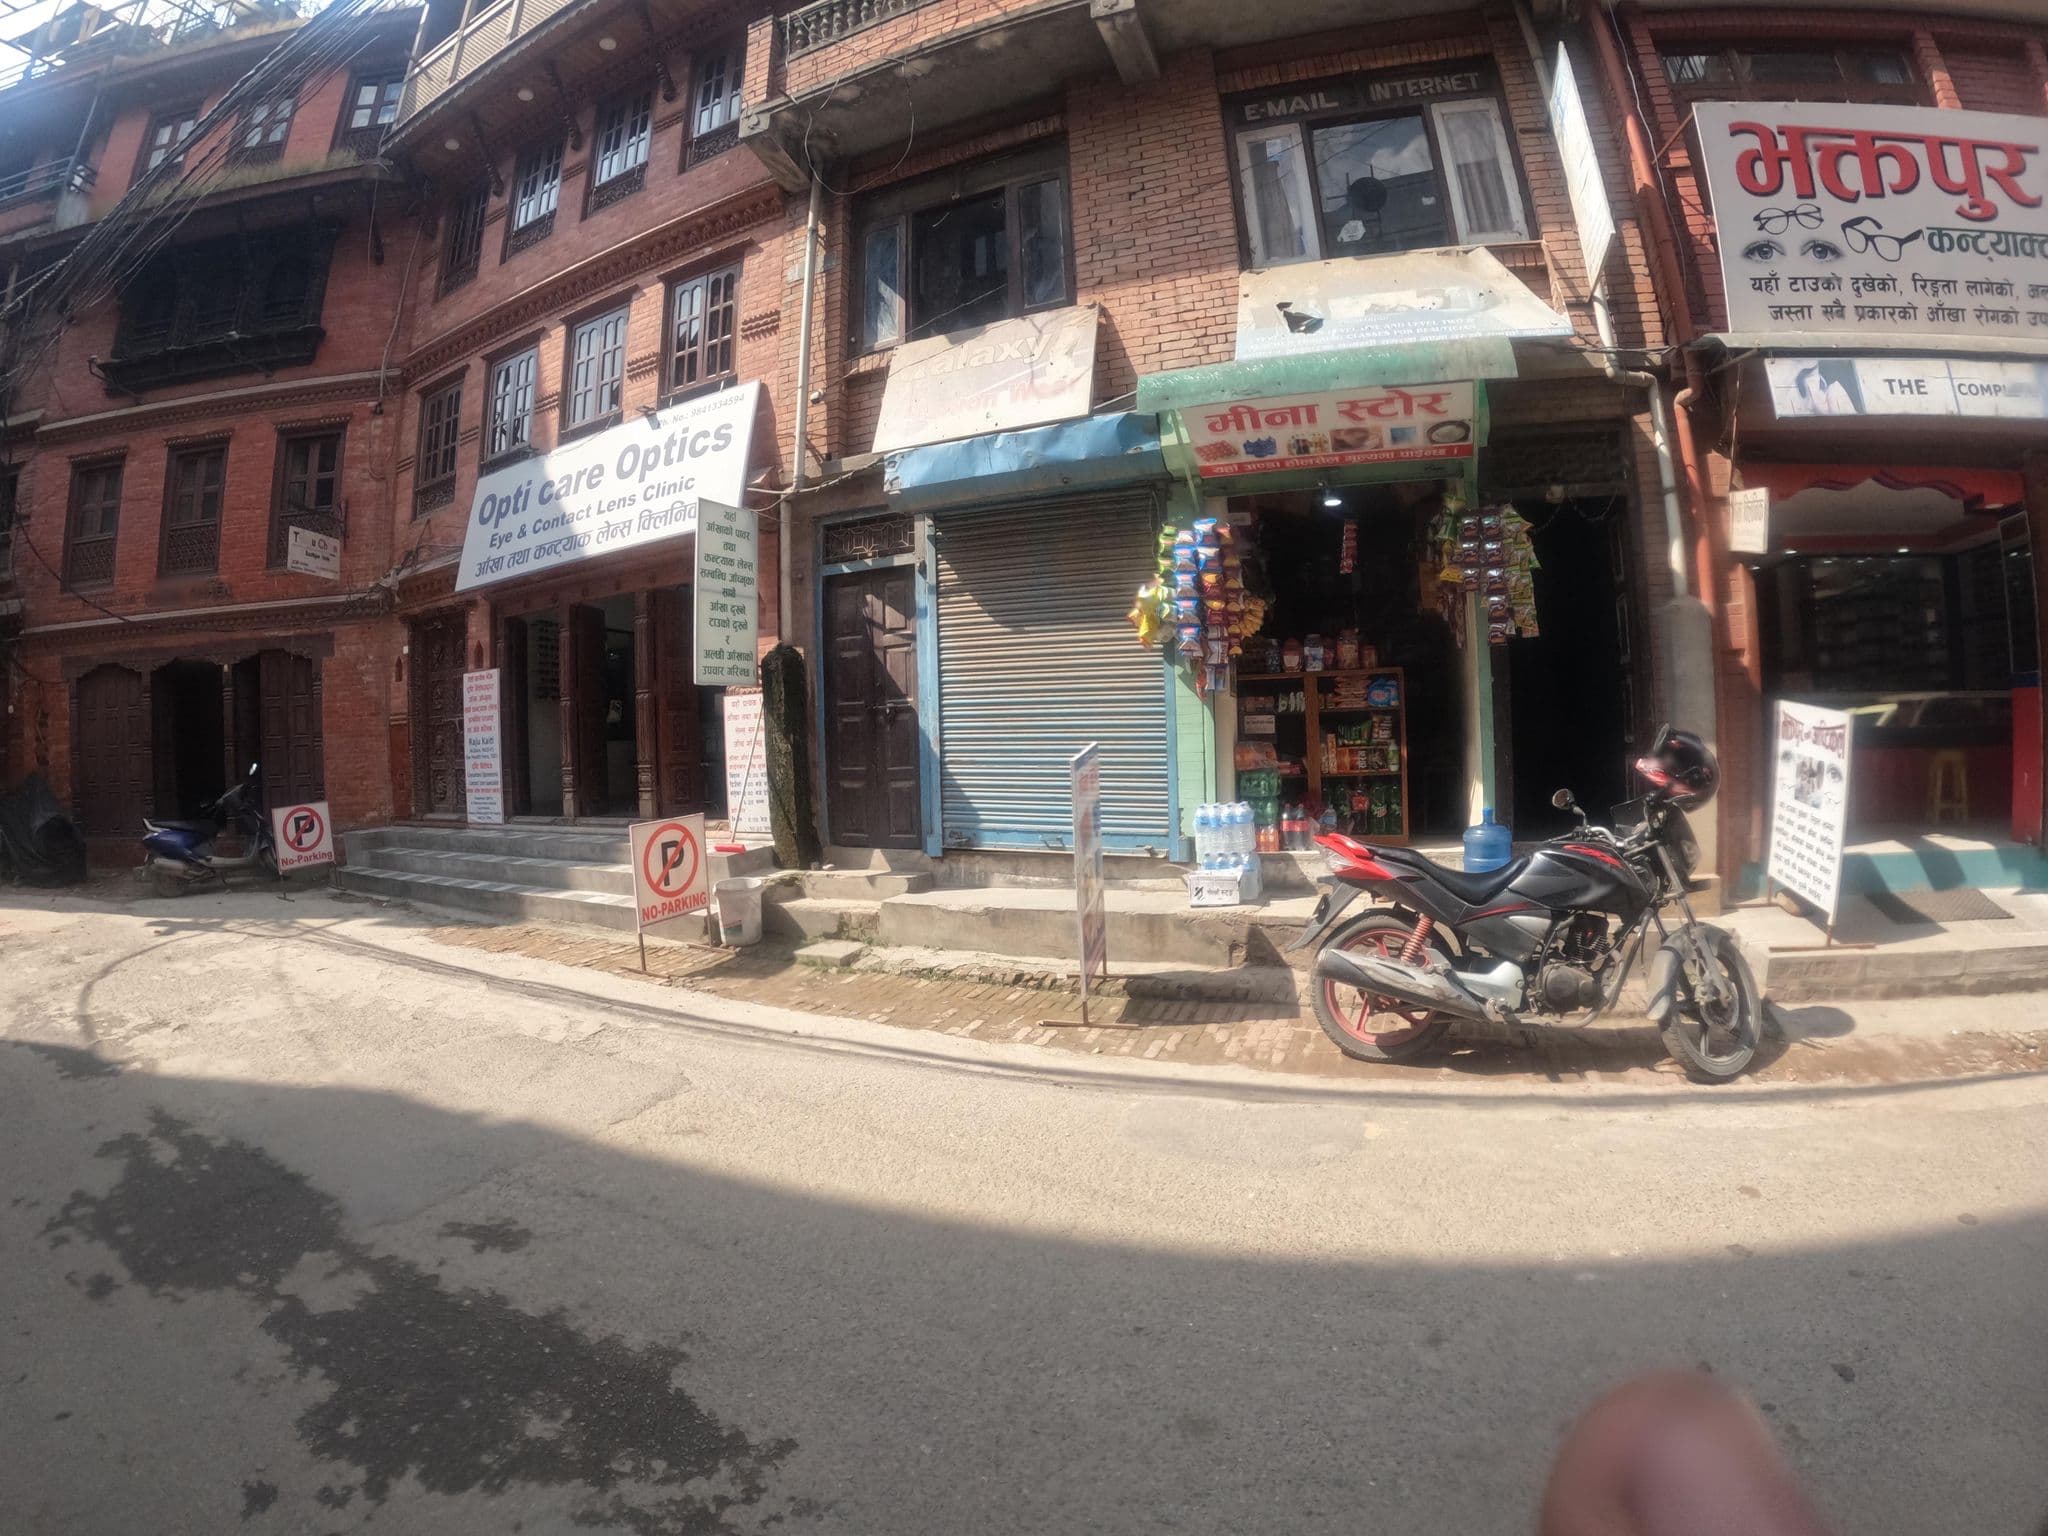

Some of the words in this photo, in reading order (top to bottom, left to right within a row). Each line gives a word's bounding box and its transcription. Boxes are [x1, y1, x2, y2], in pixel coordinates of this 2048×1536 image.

[1244, 91, 1340, 121] E-MAIL
[1369, 72, 1480, 101] INTERNET
[1728, 121, 2043, 222] भक्तपुर
[1788, 272, 1843, 293] टाउको
[1768, 304, 1813, 322] जस्ता
[1821, 298, 1846, 321] सबै
[1854, 301, 1919, 324] प्रकारको
[1883, 377, 1929, 396] THE
[1204, 404, 1320, 434] मीना
[1336, 388, 1452, 422] स्टोर
[478, 480, 533, 530] Opti
[538, 463, 605, 507] care
[616, 422, 733, 483] Optics
[489, 531, 512, 549] Eye
[517, 523, 527, 540] &
[533, 504, 592, 535] Contact
[597, 494, 636, 516] Lens
[643, 476, 695, 501] Clinic
[507, 547, 531, 570] तथा
[597, 520, 635, 545] लेन्स
[281, 851, 333, 867] No-Parking
[641, 891, 708, 921] NO-PARKING
